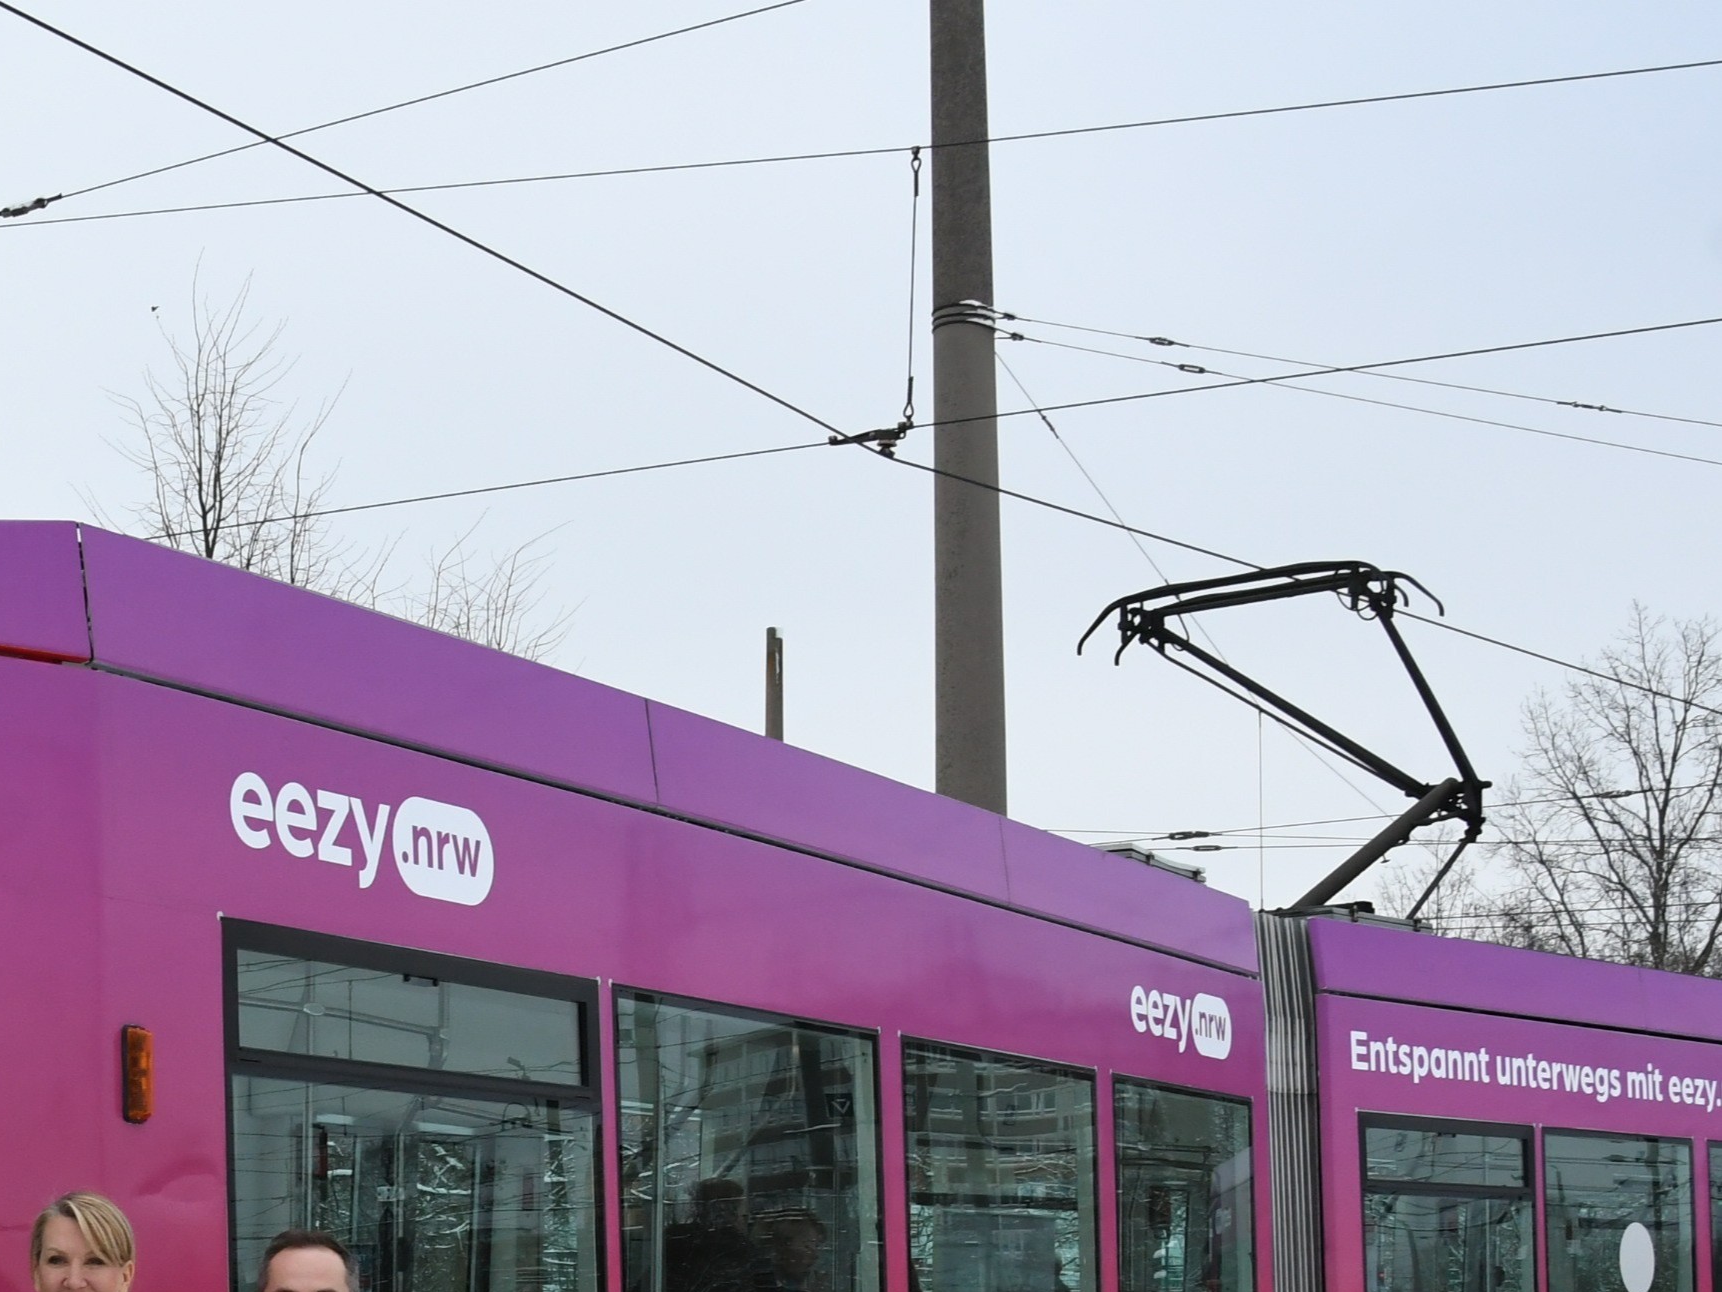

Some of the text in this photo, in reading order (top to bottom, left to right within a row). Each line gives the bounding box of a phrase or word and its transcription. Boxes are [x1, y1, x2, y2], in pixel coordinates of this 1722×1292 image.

[230, 772, 488, 892] eezy.nrw
[1130, 985, 1228, 1054] eezy.nrw
[1350, 1030, 1490, 1083] Entspannt
[1496, 1053, 1622, 1103] unterwegs
[1626, 1062, 1664, 1102] mit
